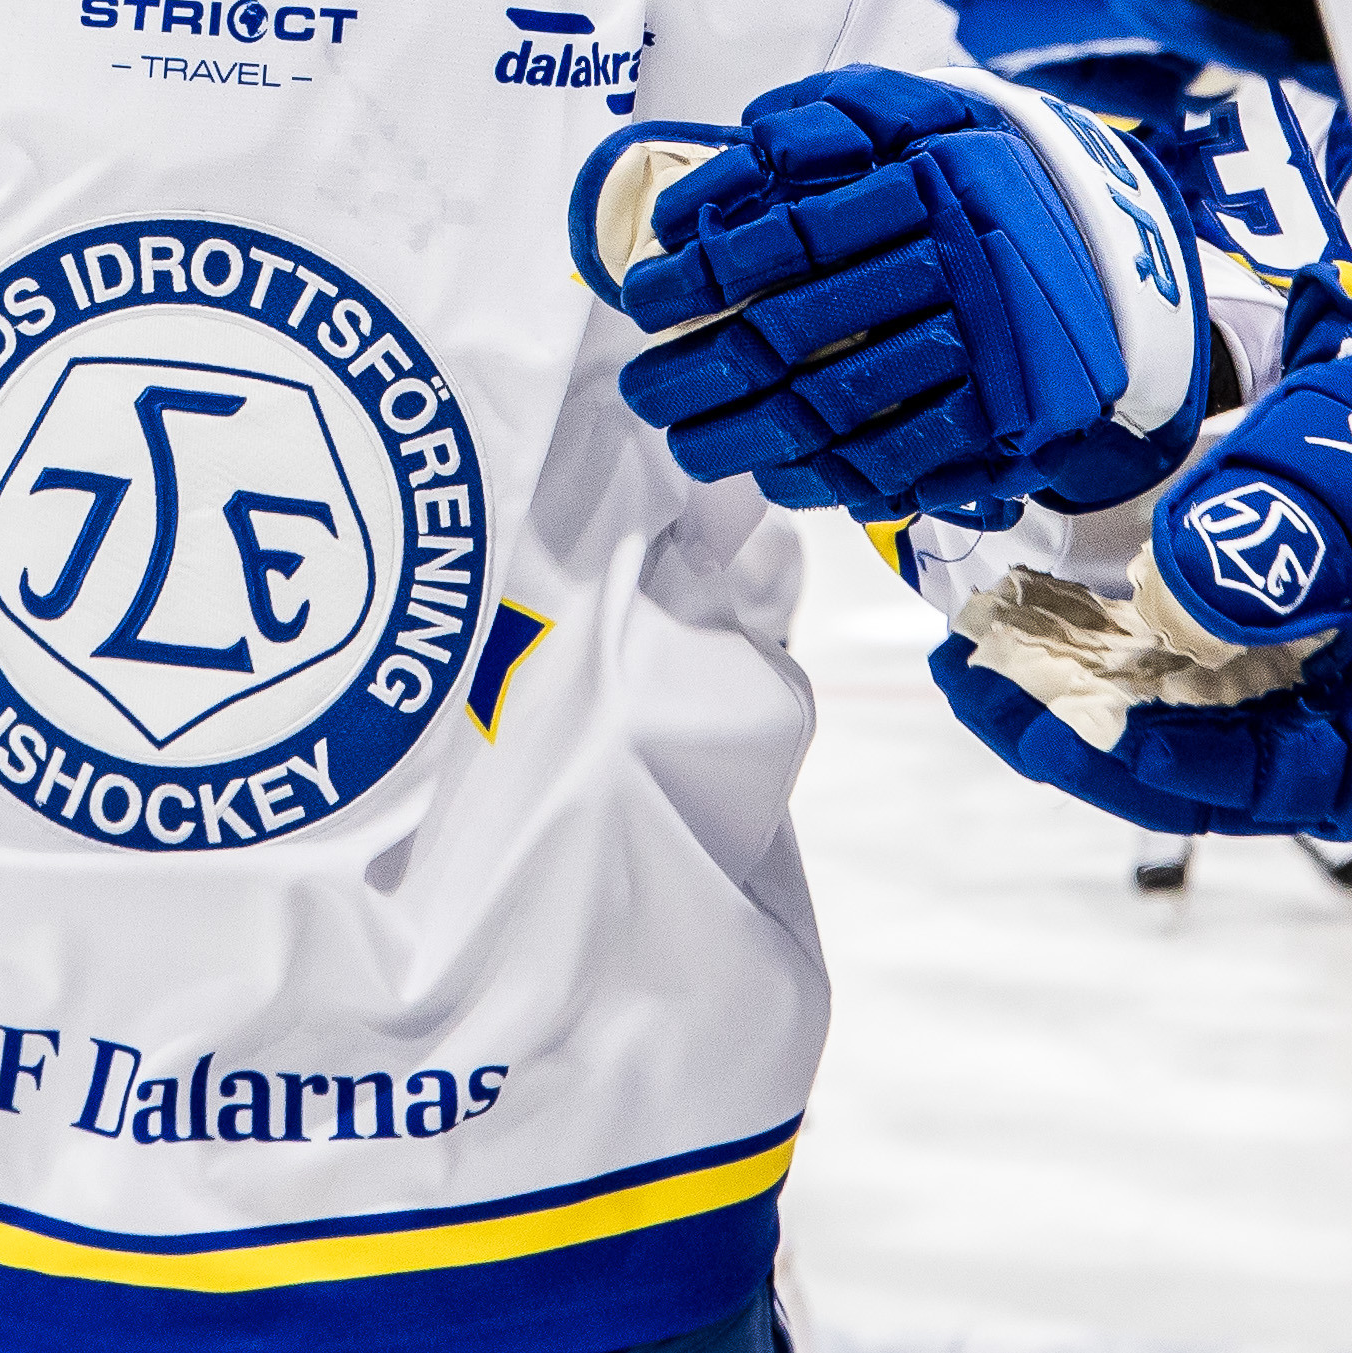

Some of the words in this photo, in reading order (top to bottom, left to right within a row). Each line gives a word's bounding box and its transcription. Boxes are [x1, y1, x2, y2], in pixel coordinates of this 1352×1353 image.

[141, 55, 281, 88] TRAVEL
[59, 235, 474, 715] IDROTTSFÖRENING
[68, 1037, 510, 1146] Dalarnas
